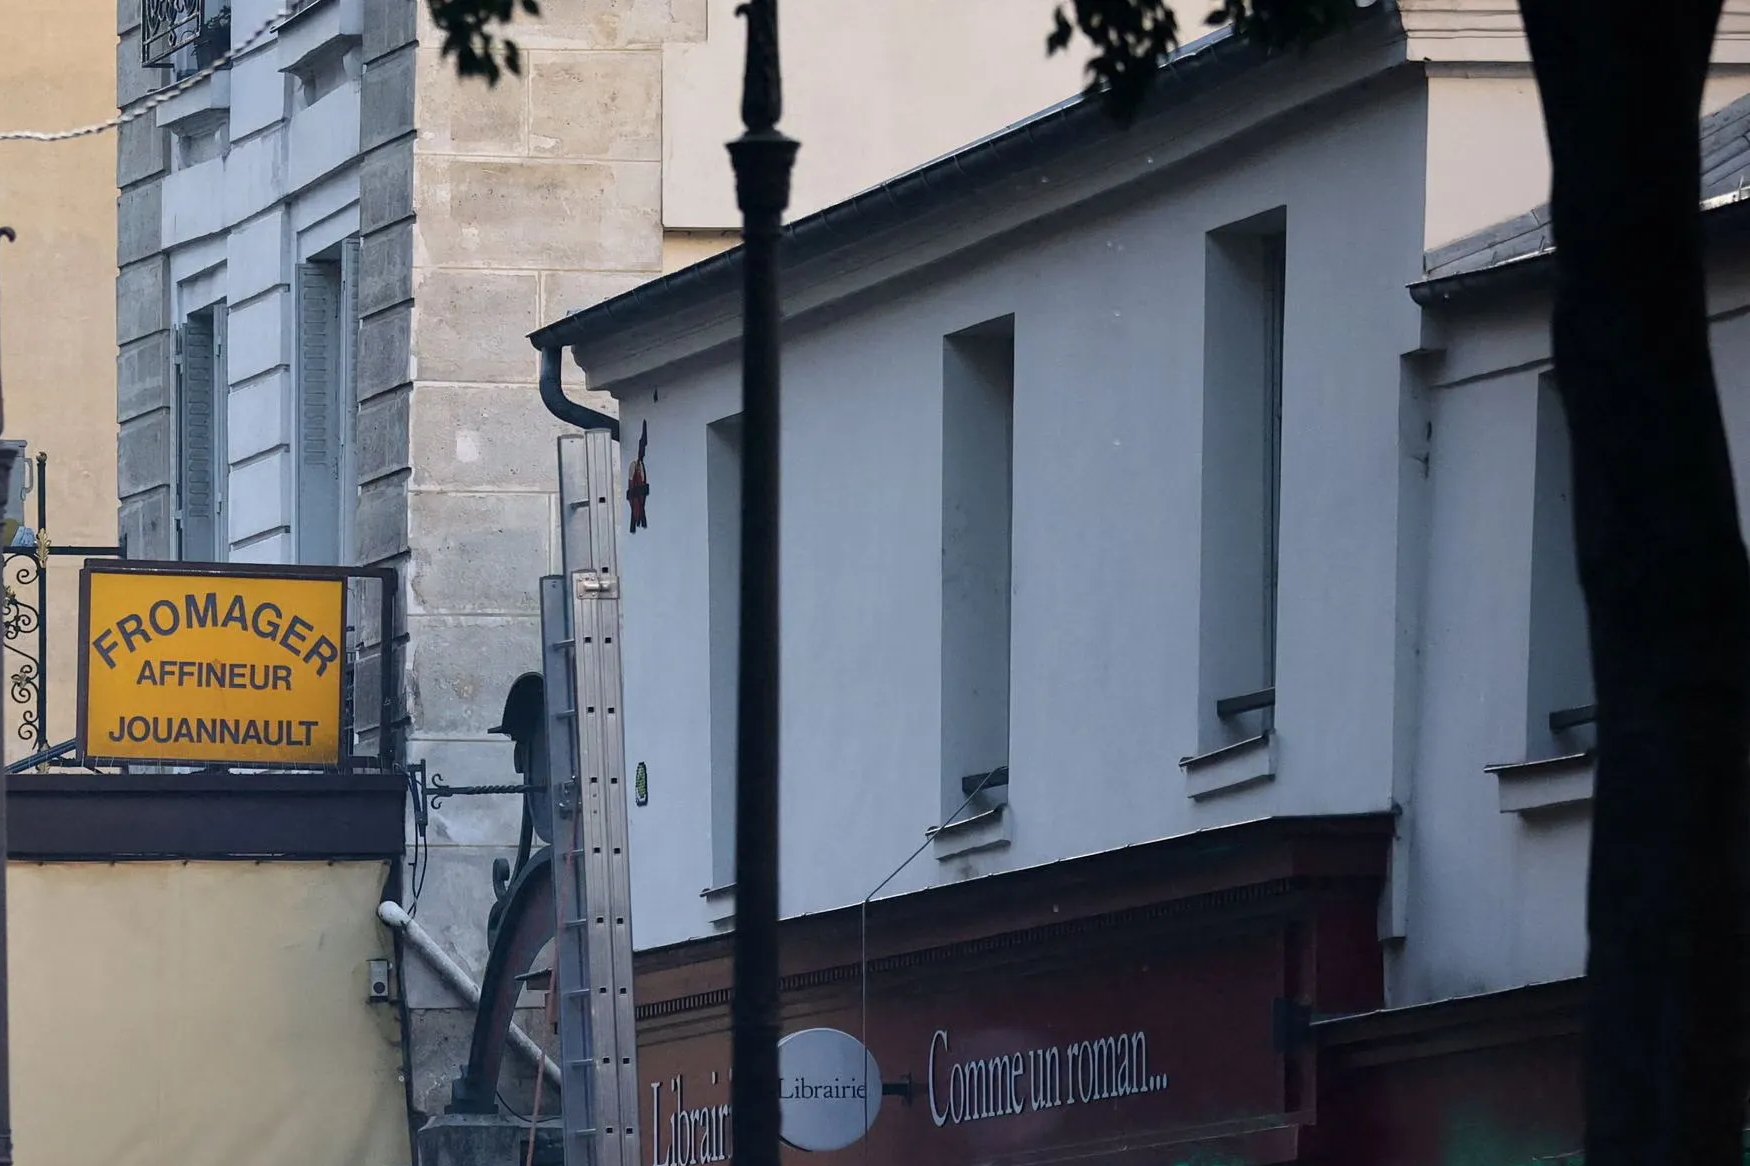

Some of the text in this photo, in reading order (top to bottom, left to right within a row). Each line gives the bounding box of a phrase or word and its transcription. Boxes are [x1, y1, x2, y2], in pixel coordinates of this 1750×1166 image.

[92, 592, 338, 677] FROMAGER
[136, 660, 291, 690] AFFINEUR
[109, 716, 318, 746] JOUANNAULT
[779, 1078, 866, 1099] Librairie
[928, 1030, 1167, 1127] Comme un roman...
